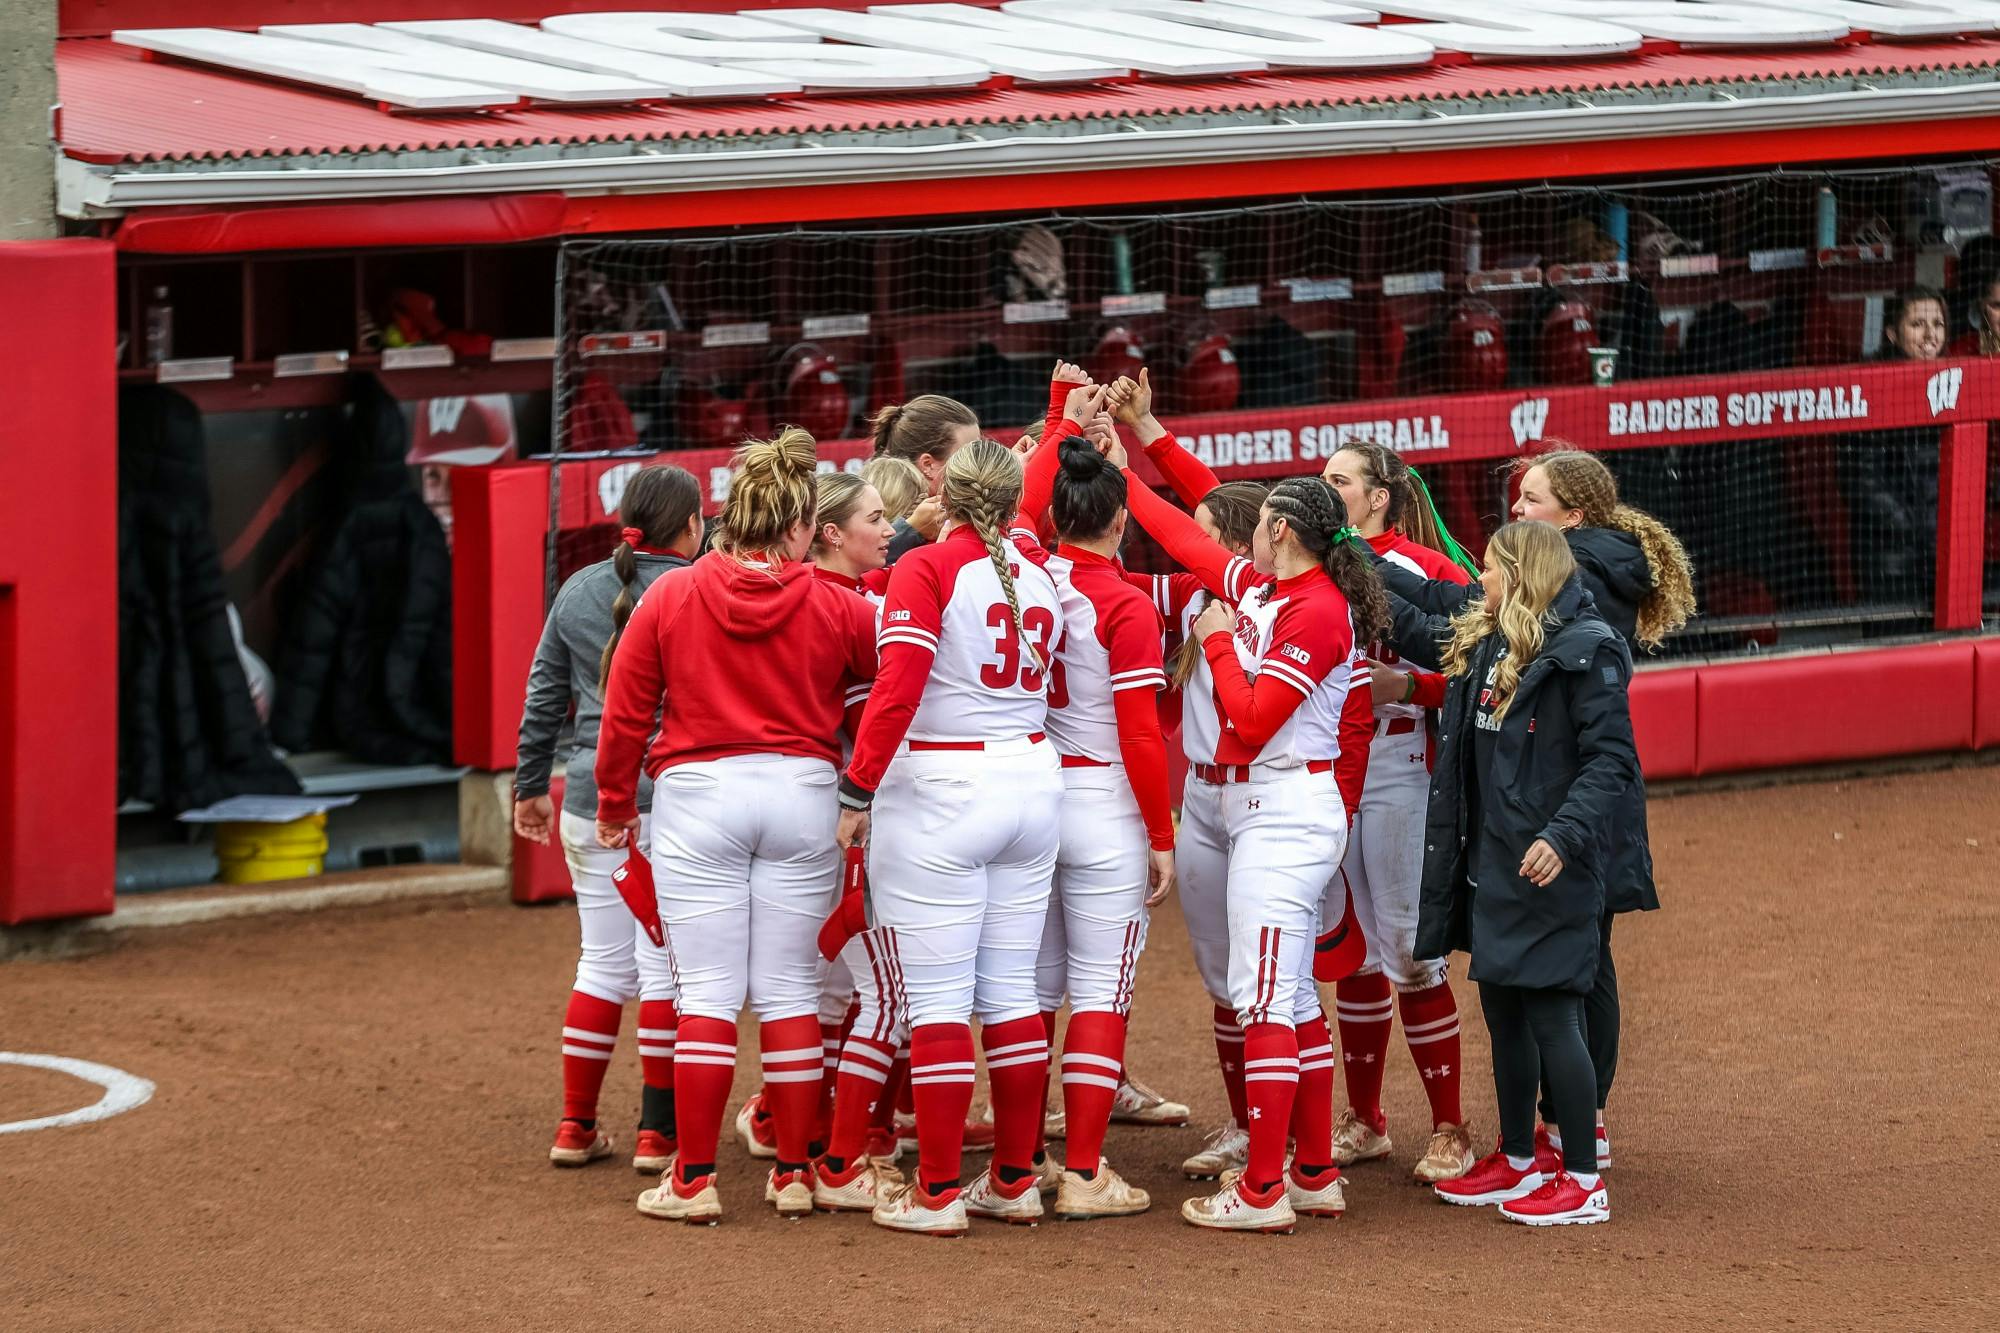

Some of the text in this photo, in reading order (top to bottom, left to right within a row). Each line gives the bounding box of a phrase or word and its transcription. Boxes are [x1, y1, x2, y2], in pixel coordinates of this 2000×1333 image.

[1608, 384, 1869, 436] BADGER SOFTBALL
[1926, 366, 1963, 418] W
[1300, 415, 1450, 461] SOFTBALL
[1510, 397, 1550, 448] W
[980, 602, 1054, 691] 33
